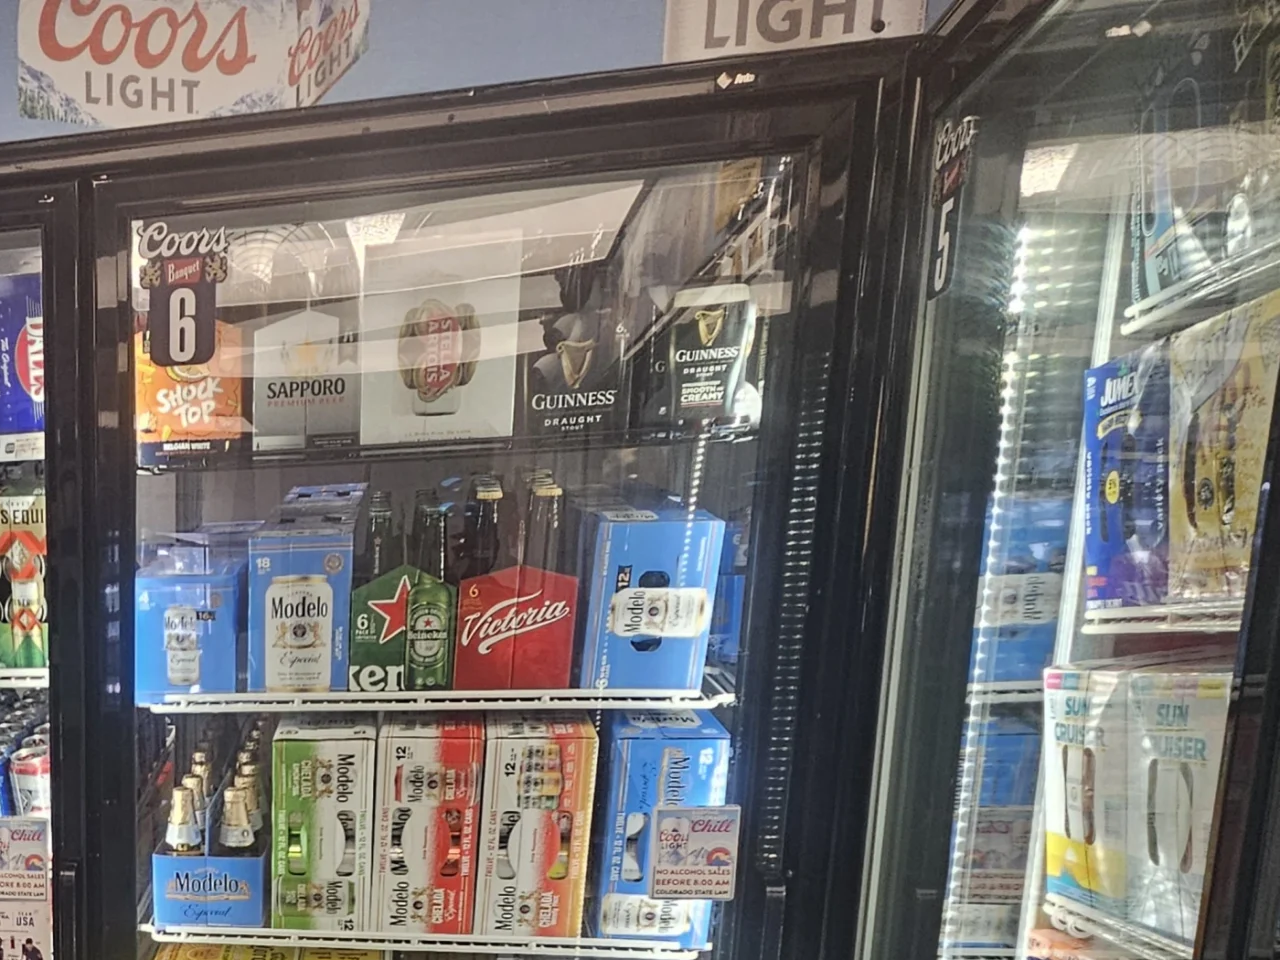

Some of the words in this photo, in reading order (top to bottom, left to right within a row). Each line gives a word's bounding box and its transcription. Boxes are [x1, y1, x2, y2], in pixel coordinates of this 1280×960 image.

[38, 0, 257, 76] Coors
[287, 0, 360, 87] Coors
[85, 71, 200, 114] LIGHT
[138, 221, 229, 259] Coors
[933, 197, 955, 293] 5
[170, 287, 196, 362] 6
[425, 320, 439, 385] ARTOIS
[436, 316, 454, 383] STELLA
[675, 346, 741, 363] GUINNESS
[682, 364, 729, 375] DRAUGHT
[156, 376, 224, 414] SHOCK
[267, 377, 346, 400] SAPPORO
[531, 389, 618, 411] GUINNESS
[173, 399, 216, 428] TOP
[544, 414, 603, 428] DRAUGHT
[256, 558, 270, 569] 18
[271, 595, 329, 620] Modelo
[623, 590, 646, 633] Modelo
[356, 613, 369, 630] 6
[460, 589, 570, 655] Victoria
[1155, 703, 1190, 727] SUN
[336, 753, 356, 803] Modelo
[9, 829, 44, 842] Chill
[690, 818, 733, 834] Chill
[175, 871, 239, 895] Modelo
[655, 878, 690, 887] BEFORE
[693, 878, 713, 887] 8:00
[715, 878, 731, 887] AM
[656, 868, 669, 876] NO
[670, 868, 706, 876] ALCOHOL
[707, 868, 731, 876] SALES
[389, 881, 410, 927] Modelo
[655, 888, 692, 896] COLORADO
[694, 888, 713, 896] STATE
[714, 888, 730, 896] LAW
[494, 885, 516, 931] Modelo
[16, 916, 35, 927] USA
